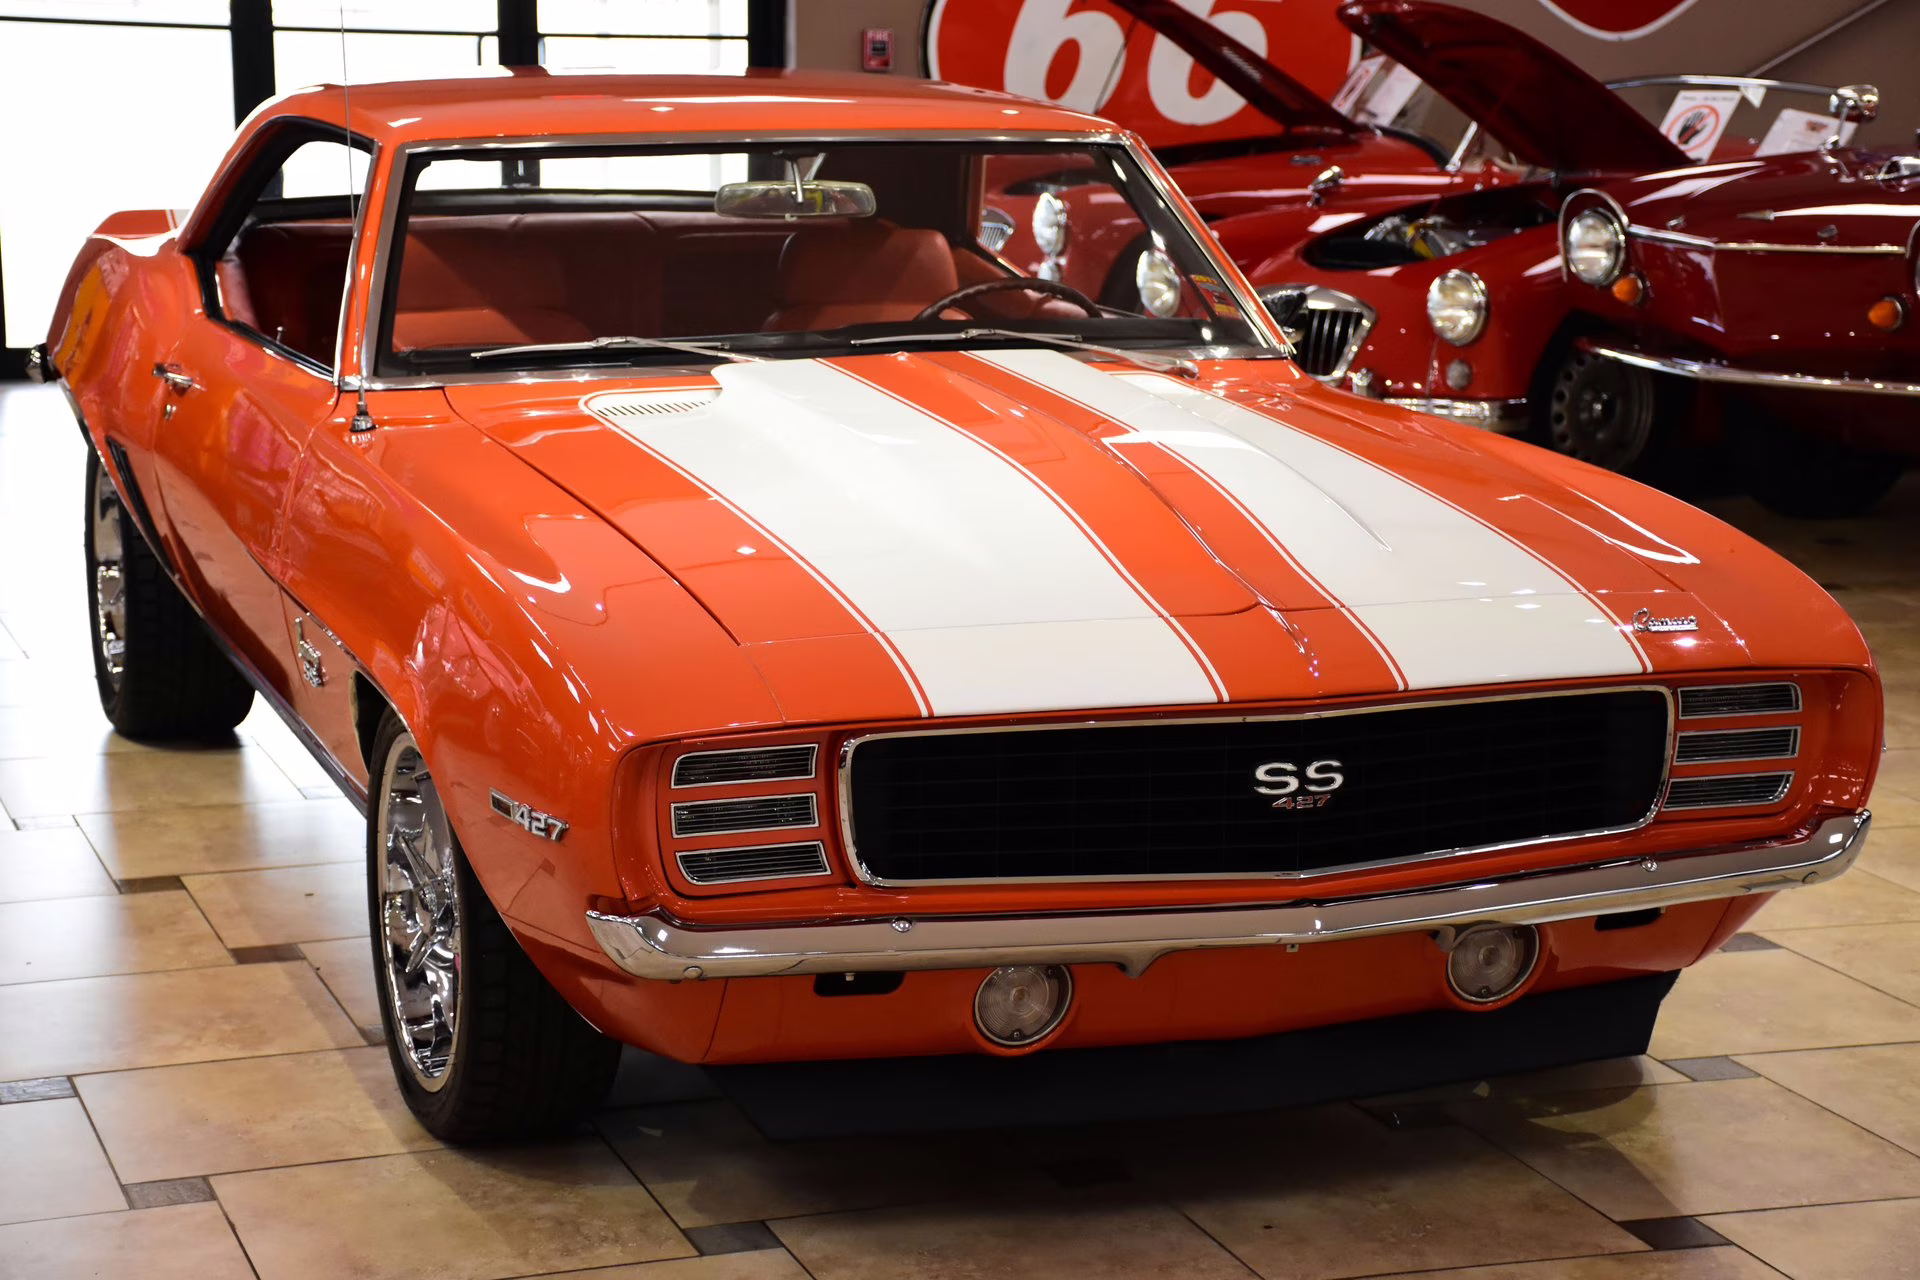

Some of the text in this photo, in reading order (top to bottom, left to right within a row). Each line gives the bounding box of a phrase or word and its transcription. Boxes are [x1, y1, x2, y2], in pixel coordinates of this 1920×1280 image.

[1003, 0, 1268, 126] 66
[1254, 760, 1344, 795] SS
[1271, 793, 1331, 810] 427
[514, 803, 566, 841] 427
